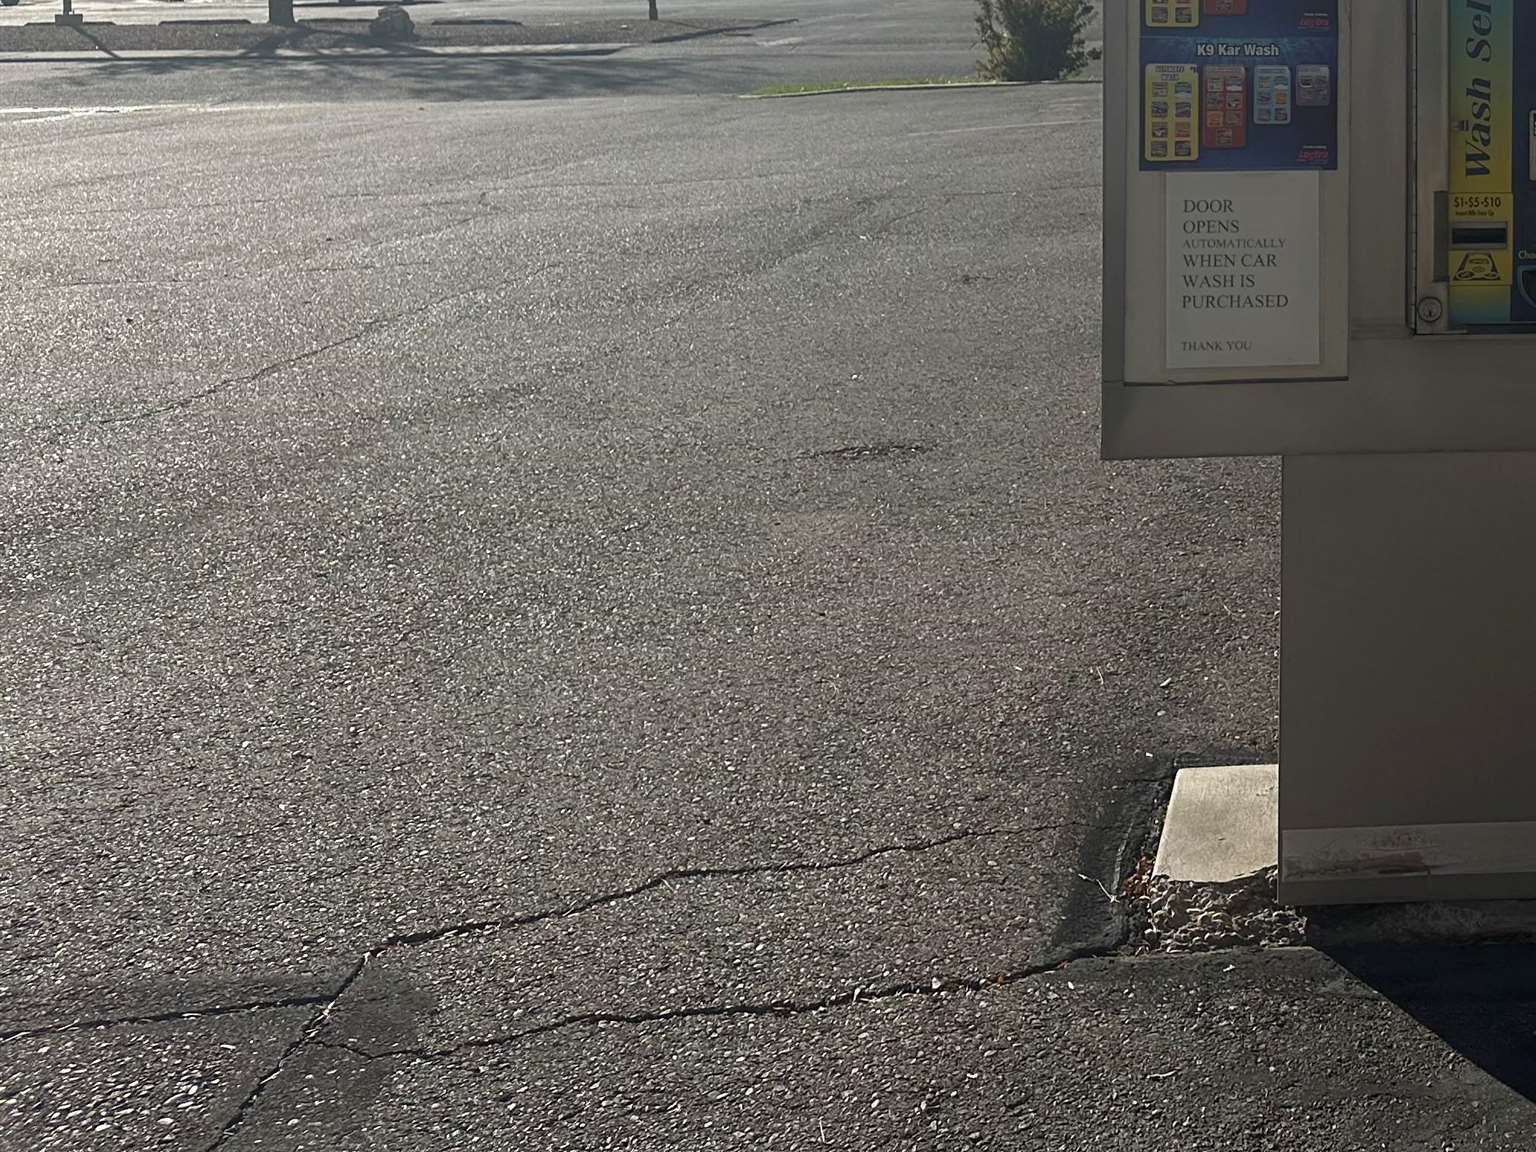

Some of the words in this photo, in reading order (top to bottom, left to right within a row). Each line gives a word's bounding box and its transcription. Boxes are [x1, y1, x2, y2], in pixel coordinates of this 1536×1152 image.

[1196, 43, 1215, 57] K9
[1217, 43, 1241, 57] Kar
[1243, 43, 1280, 57] Wash
[1465, 77, 1492, 179] Wash
[1182, 199, 1236, 214] DOOR
[1182, 219, 1241, 234] OPENS
[1182, 237, 1287, 249] AUTOMATICALLY
[1182, 253, 1237, 268] WHEN
[1240, 253, 1279, 268] CAR
[1181, 273, 1235, 289] WASH
[1239, 273, 1257, 288] IS
[1181, 294, 1290, 310] PURCHASED
[1181, 340, 1224, 352] THANK
[1225, 340, 1254, 352] YOU
